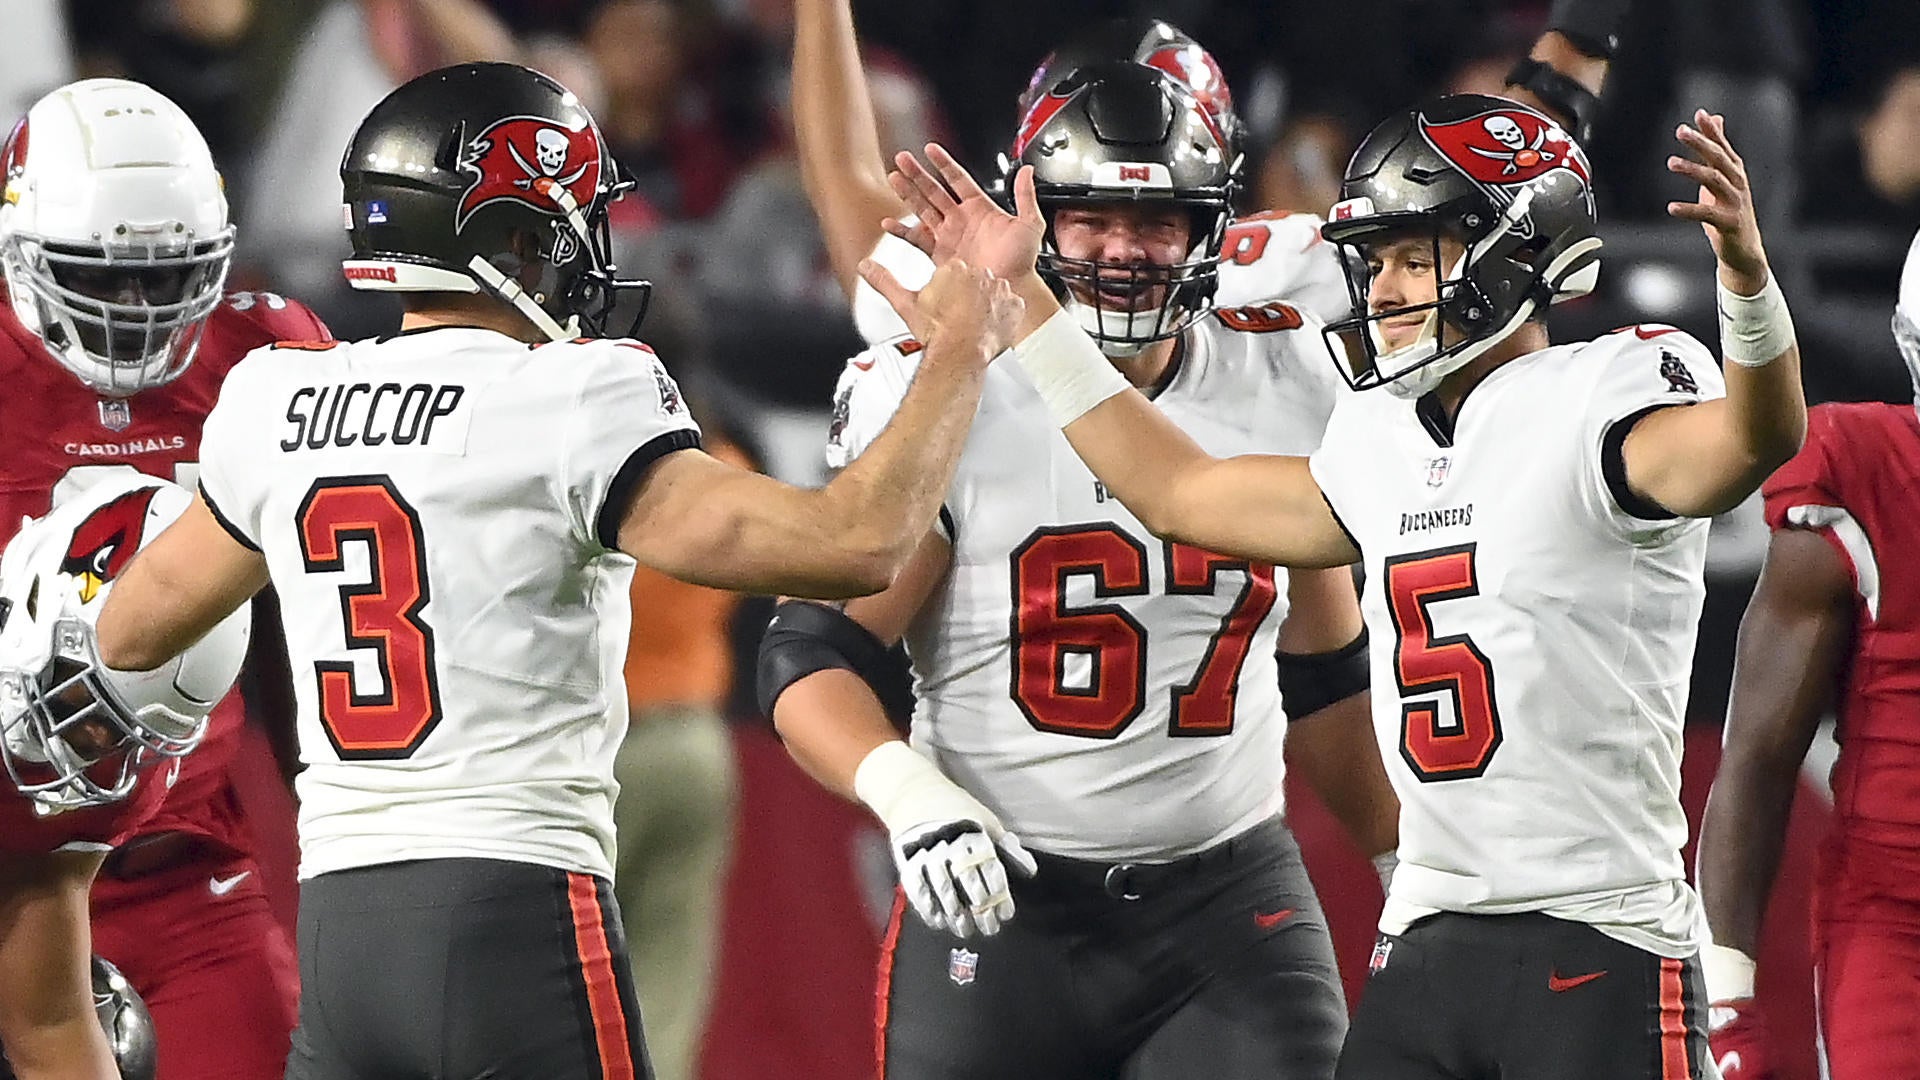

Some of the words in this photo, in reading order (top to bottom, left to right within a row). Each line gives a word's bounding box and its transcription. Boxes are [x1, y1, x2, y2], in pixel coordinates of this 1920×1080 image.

[64, 436, 185, 456] CARDINALS
[280, 383, 465, 453] SUCCOP
[1399, 503, 1473, 536] BUCCANEERS
[295, 475, 441, 761] 3
[1010, 521, 1278, 739] 67
[1385, 542, 1503, 782] 5
